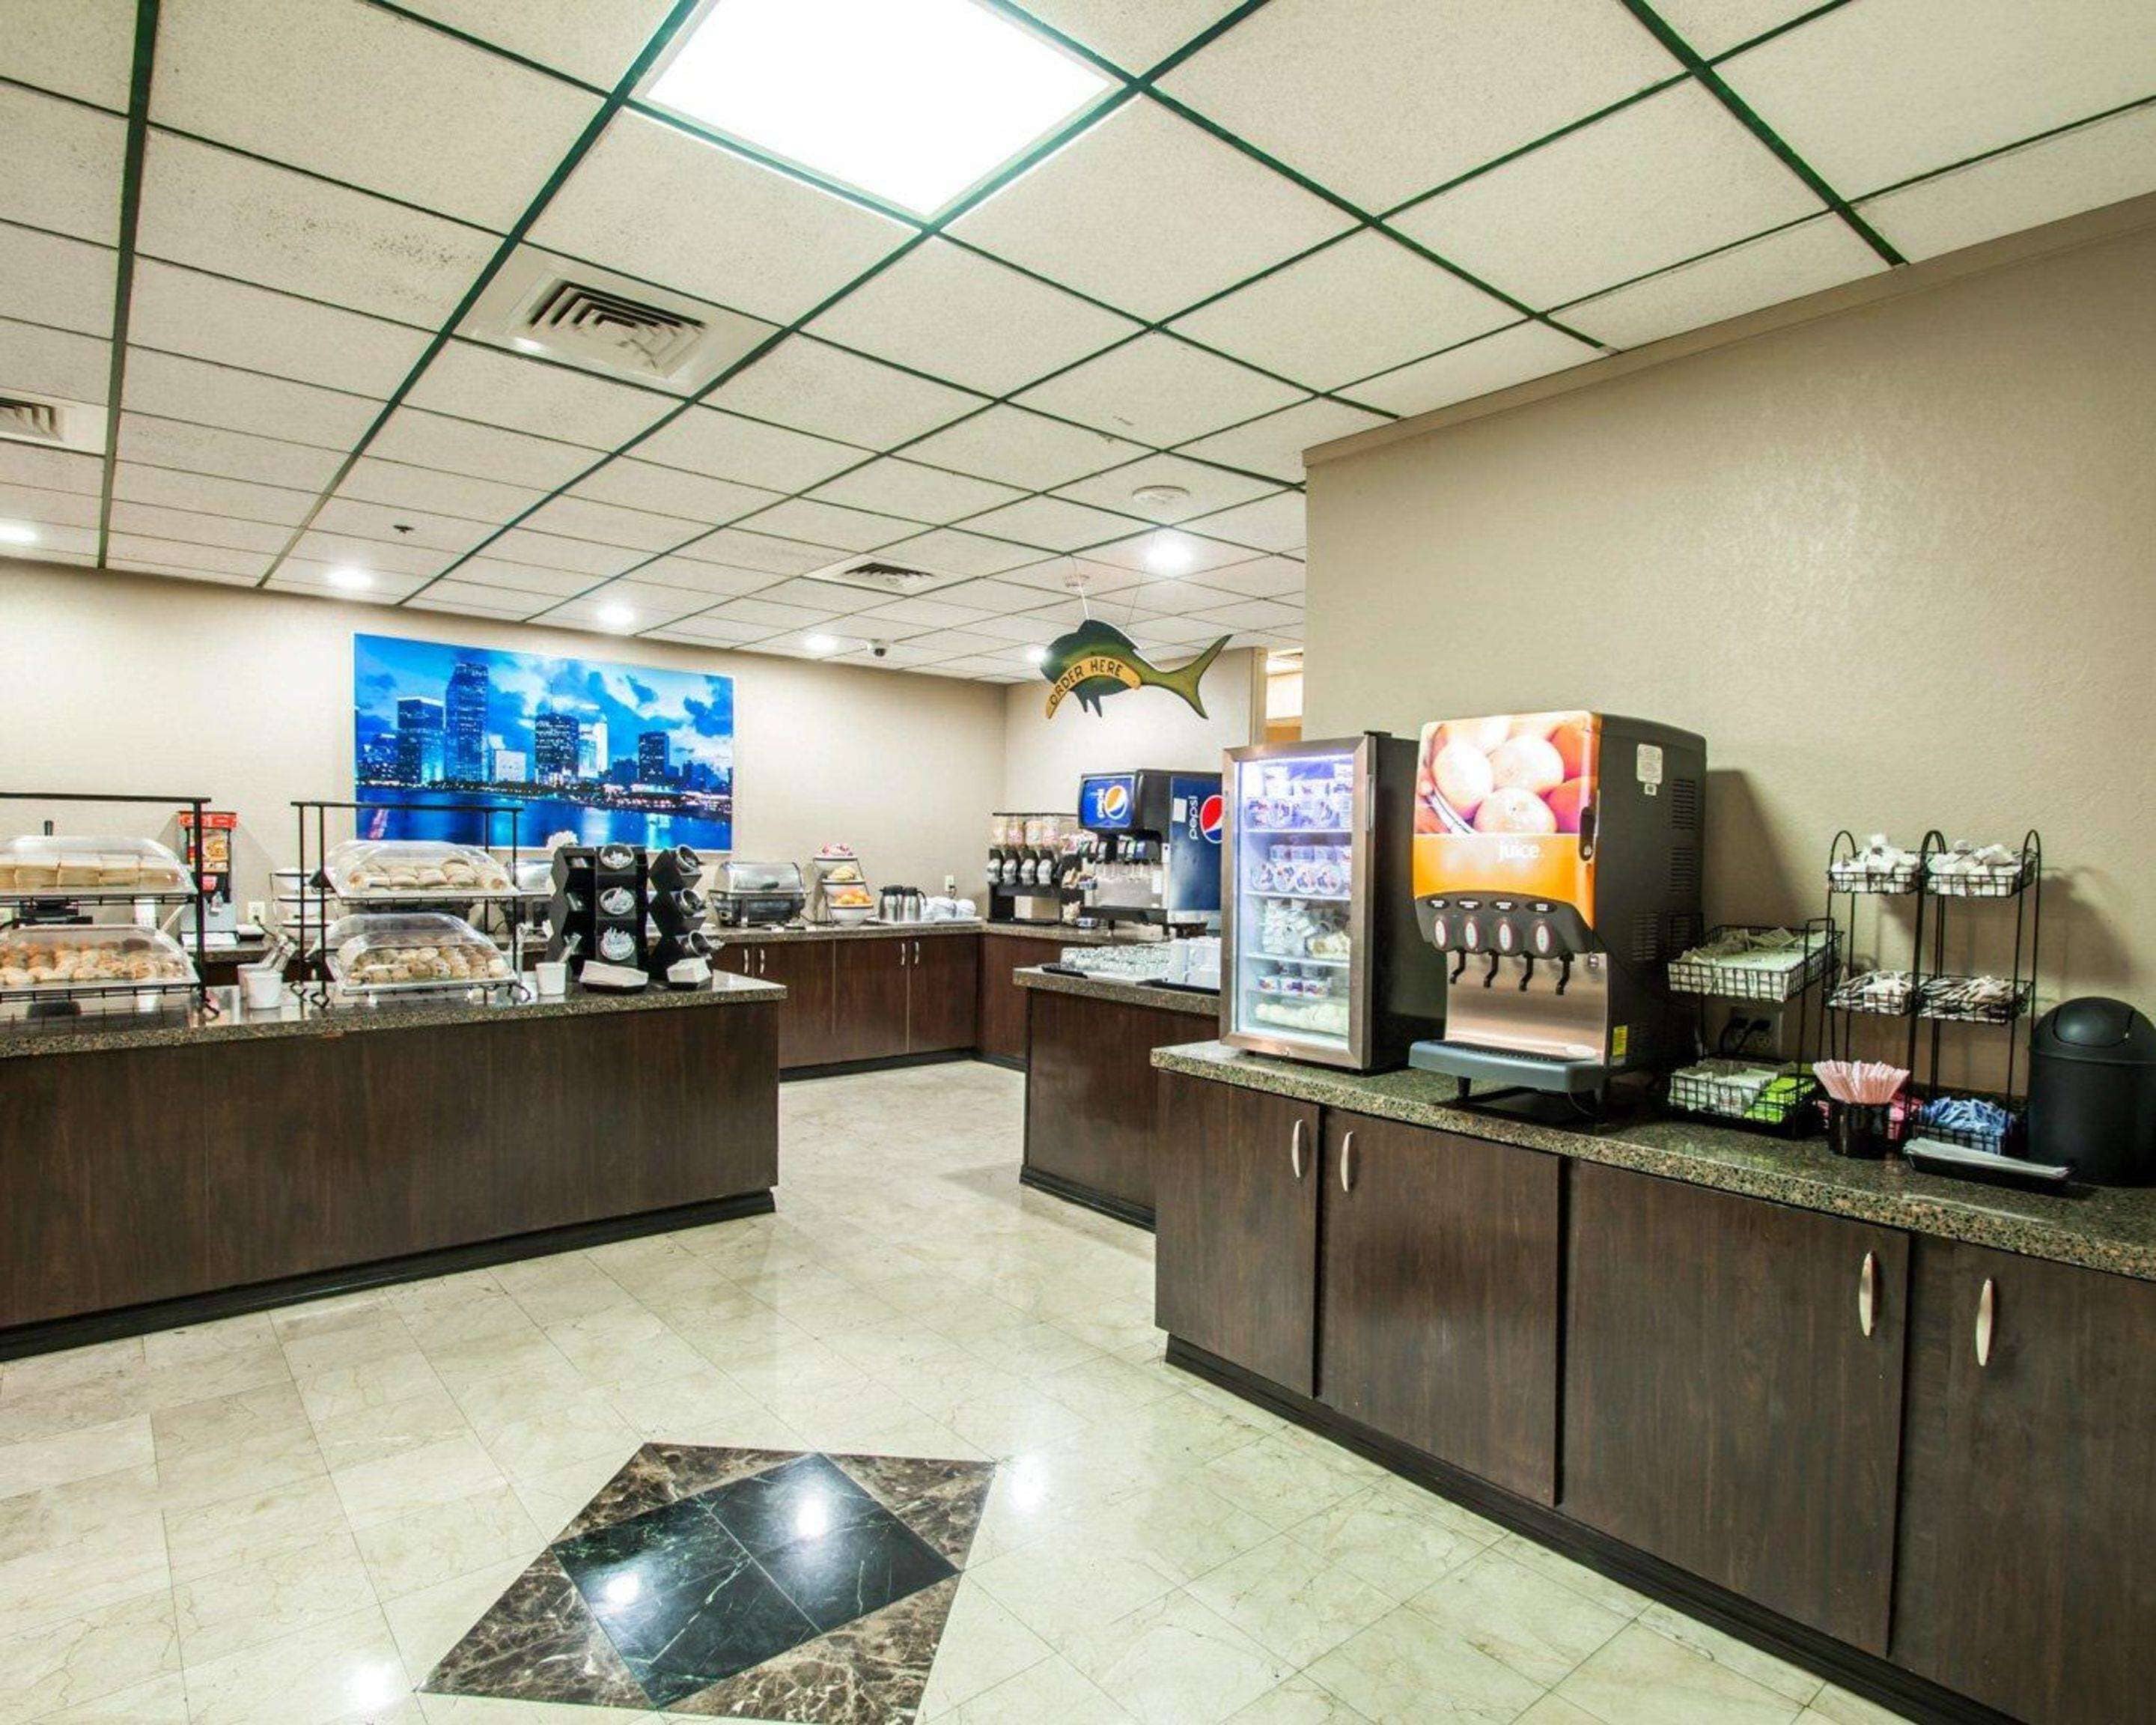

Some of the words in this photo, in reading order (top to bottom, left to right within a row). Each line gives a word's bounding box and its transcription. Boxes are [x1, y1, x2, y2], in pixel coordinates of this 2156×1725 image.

[1049, 665, 1084, 705] ORDER
[1090, 659, 1121, 677] HERE
[1188, 795, 1199, 840] pepsi
